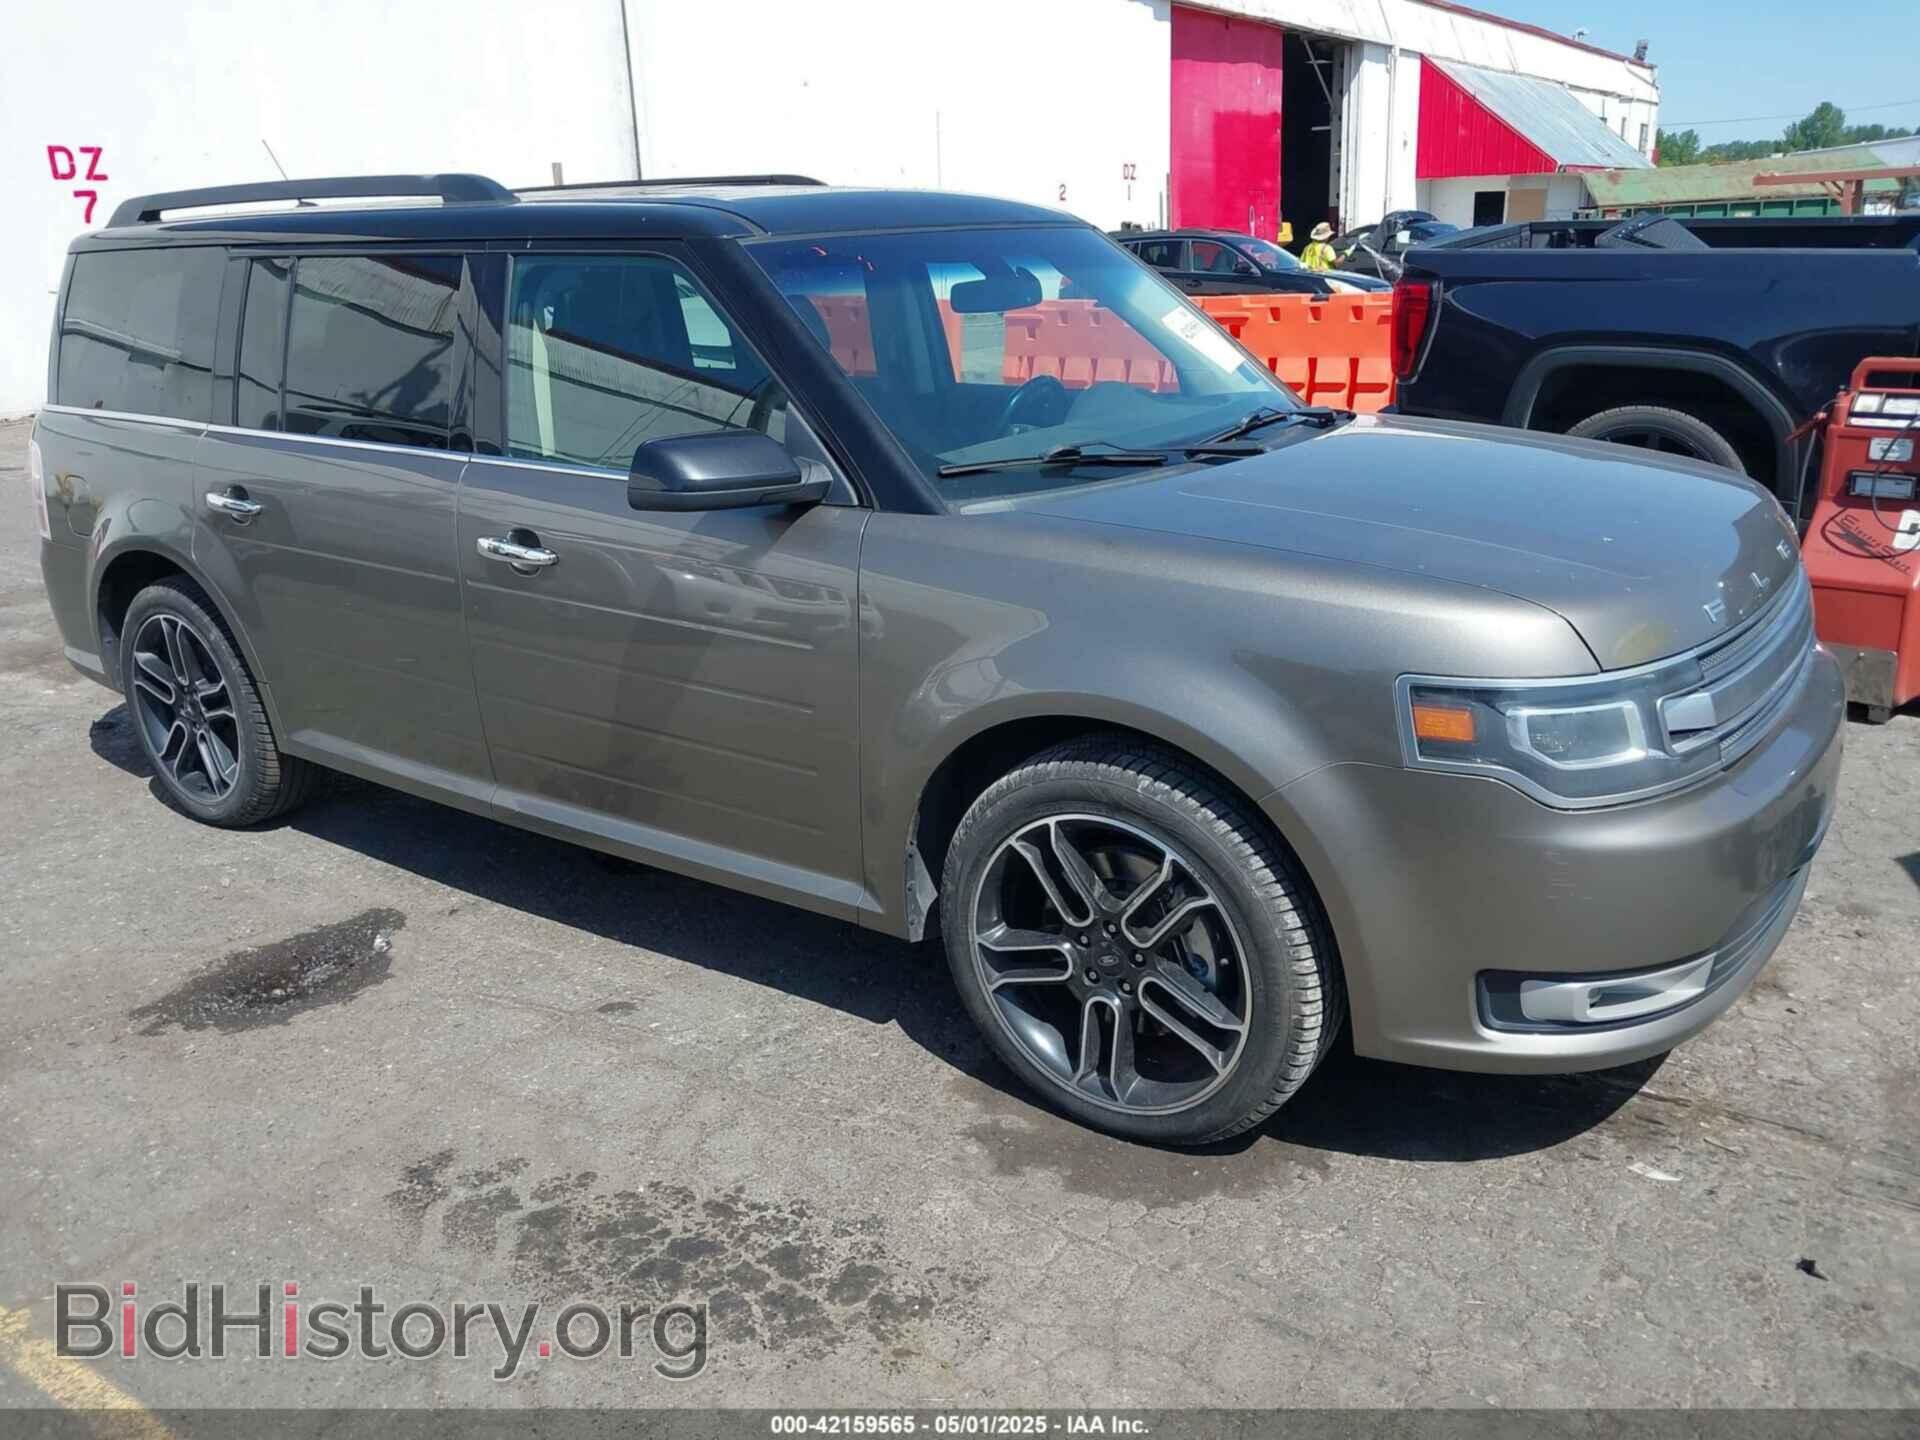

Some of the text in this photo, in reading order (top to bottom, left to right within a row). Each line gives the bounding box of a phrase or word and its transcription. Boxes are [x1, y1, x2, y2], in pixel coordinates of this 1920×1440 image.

[47, 145, 108, 181] DZ
[1123, 163, 1136, 180] DZ
[73, 190, 97, 224] 7
[1059, 184, 1066, 200] 2
[1703, 537, 1792, 624] FLE
